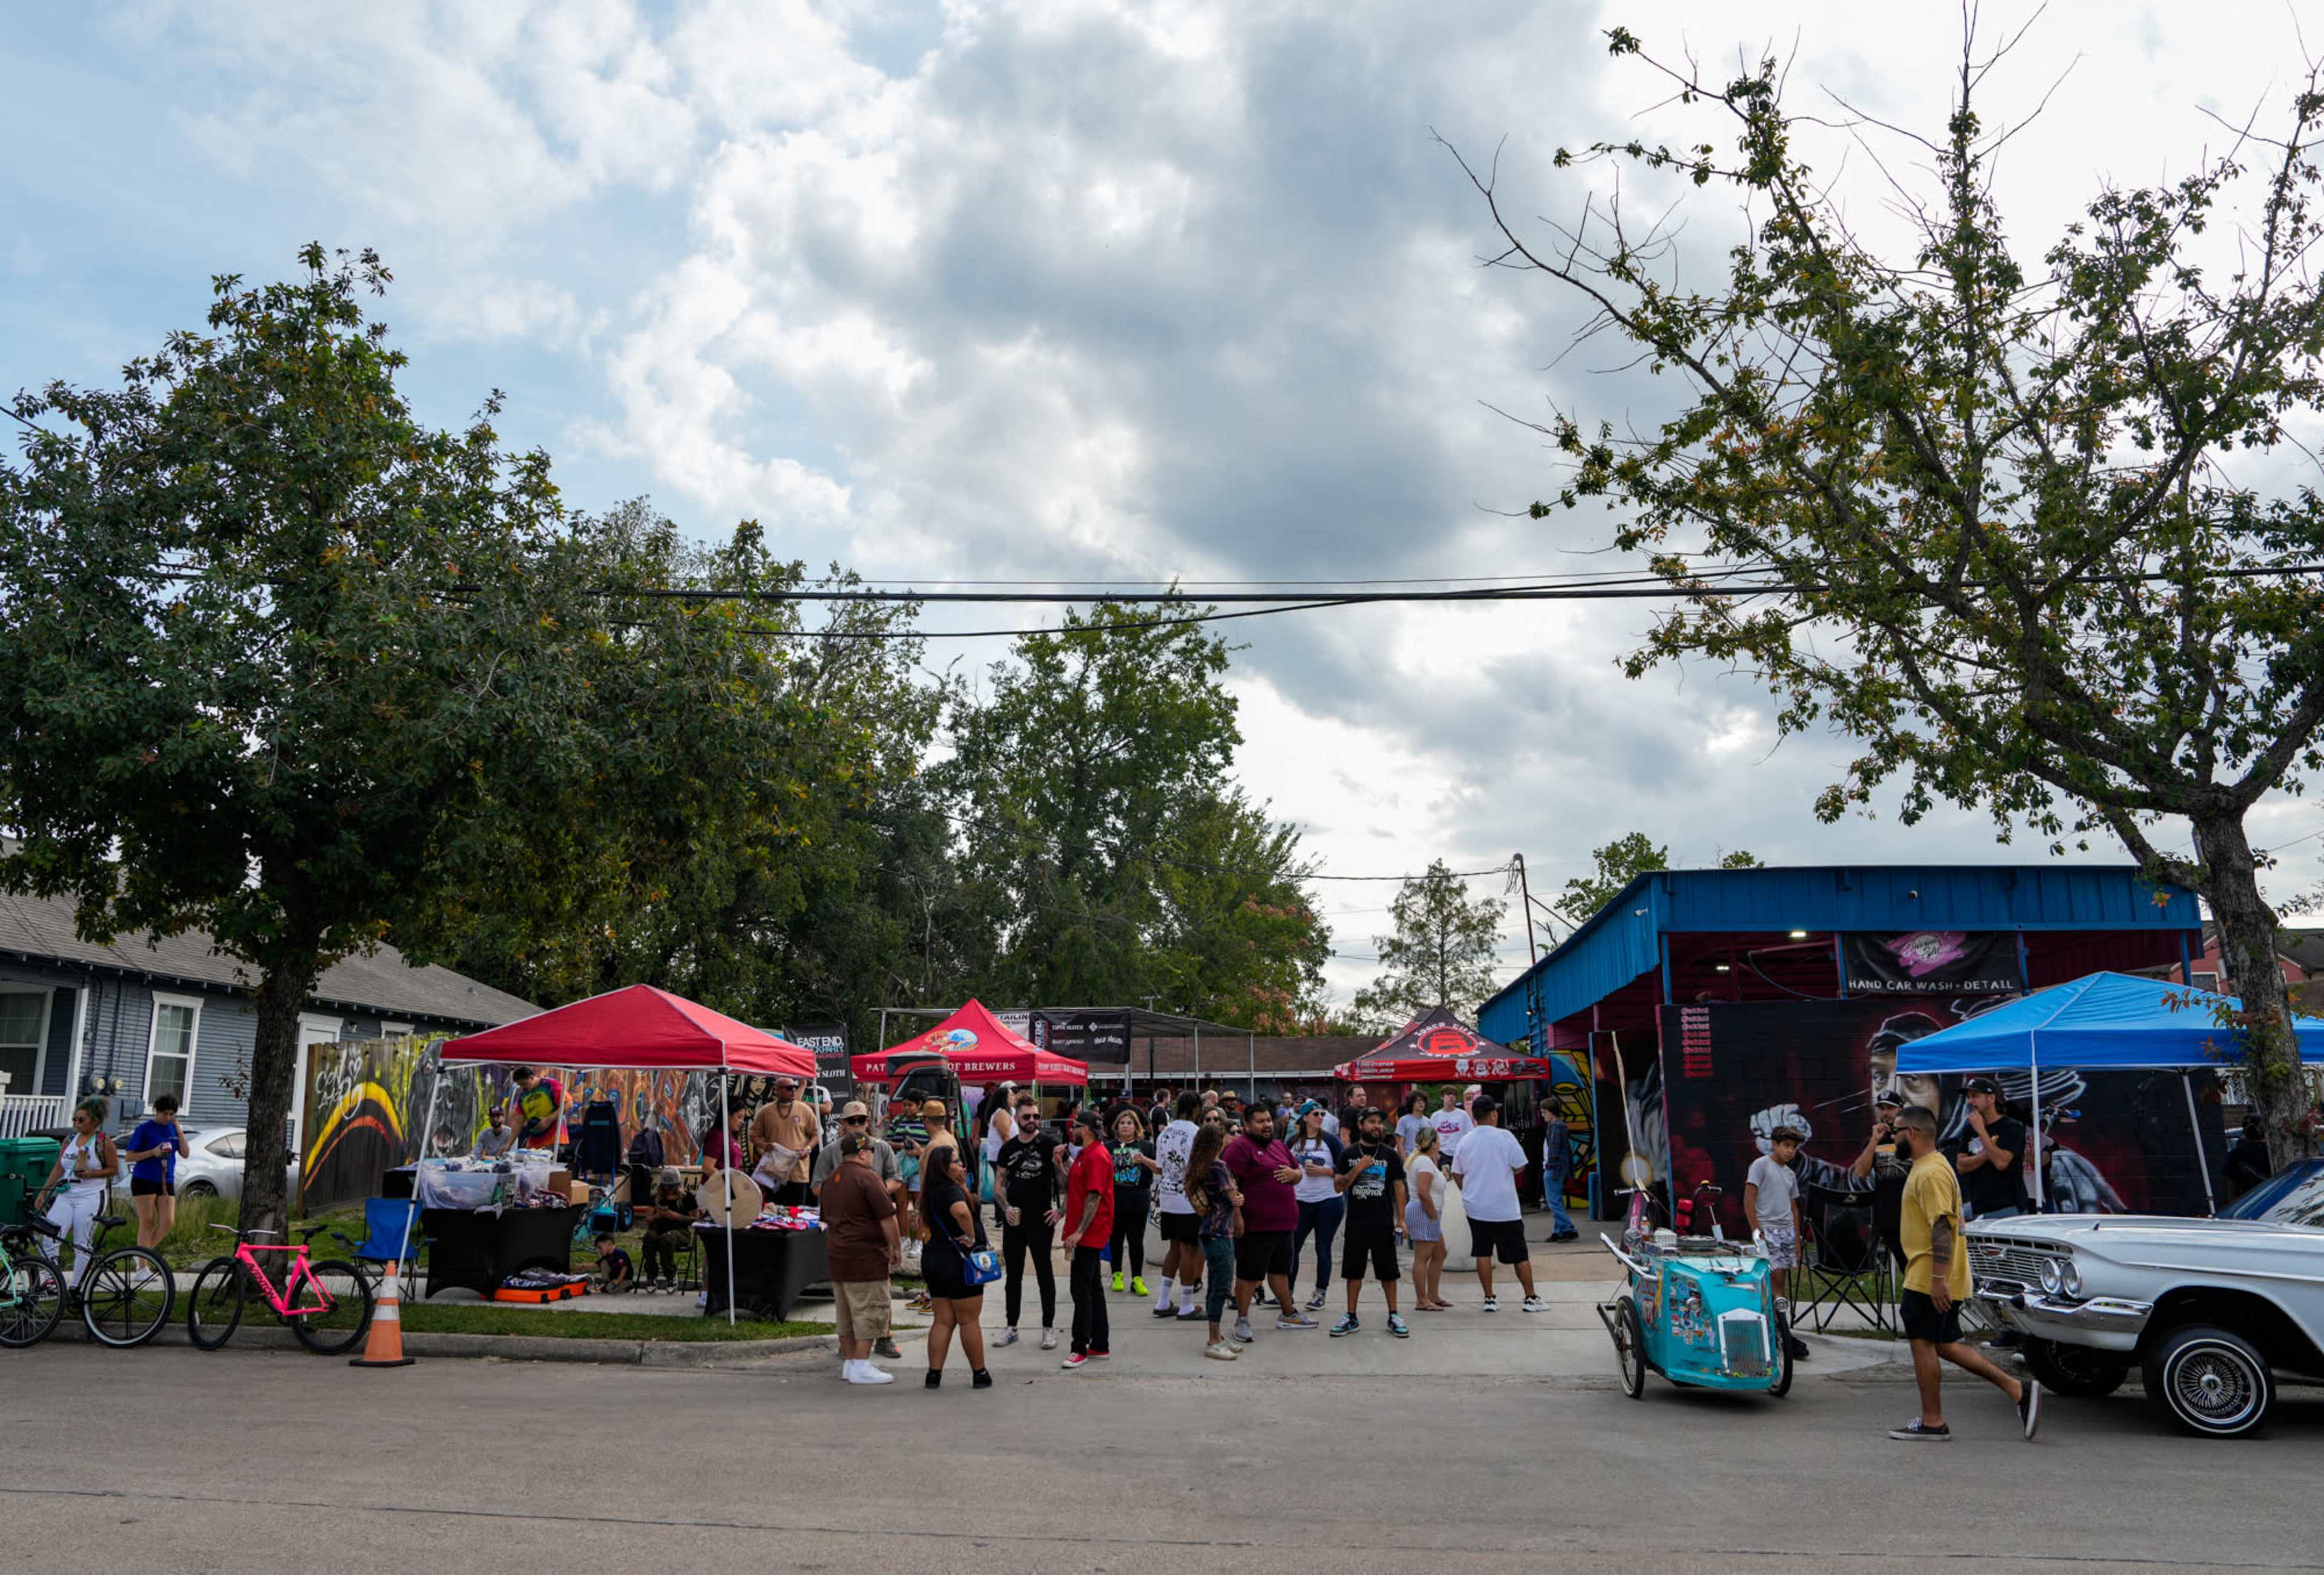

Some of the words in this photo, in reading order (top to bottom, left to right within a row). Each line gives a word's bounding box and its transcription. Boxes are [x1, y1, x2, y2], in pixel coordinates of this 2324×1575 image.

[1849, 980, 1882, 989] HAND
[1886, 981, 1912, 990] CAR
[1916, 981, 1953, 990] WASH
[1964, 980, 2014, 990] DETAIL
[796, 1036, 821, 1047] EAST
[948, 1062, 960, 1071] OF
[964, 1062, 1016, 1071] BREWERS
[245, 1263, 276, 1299] AVENTON
